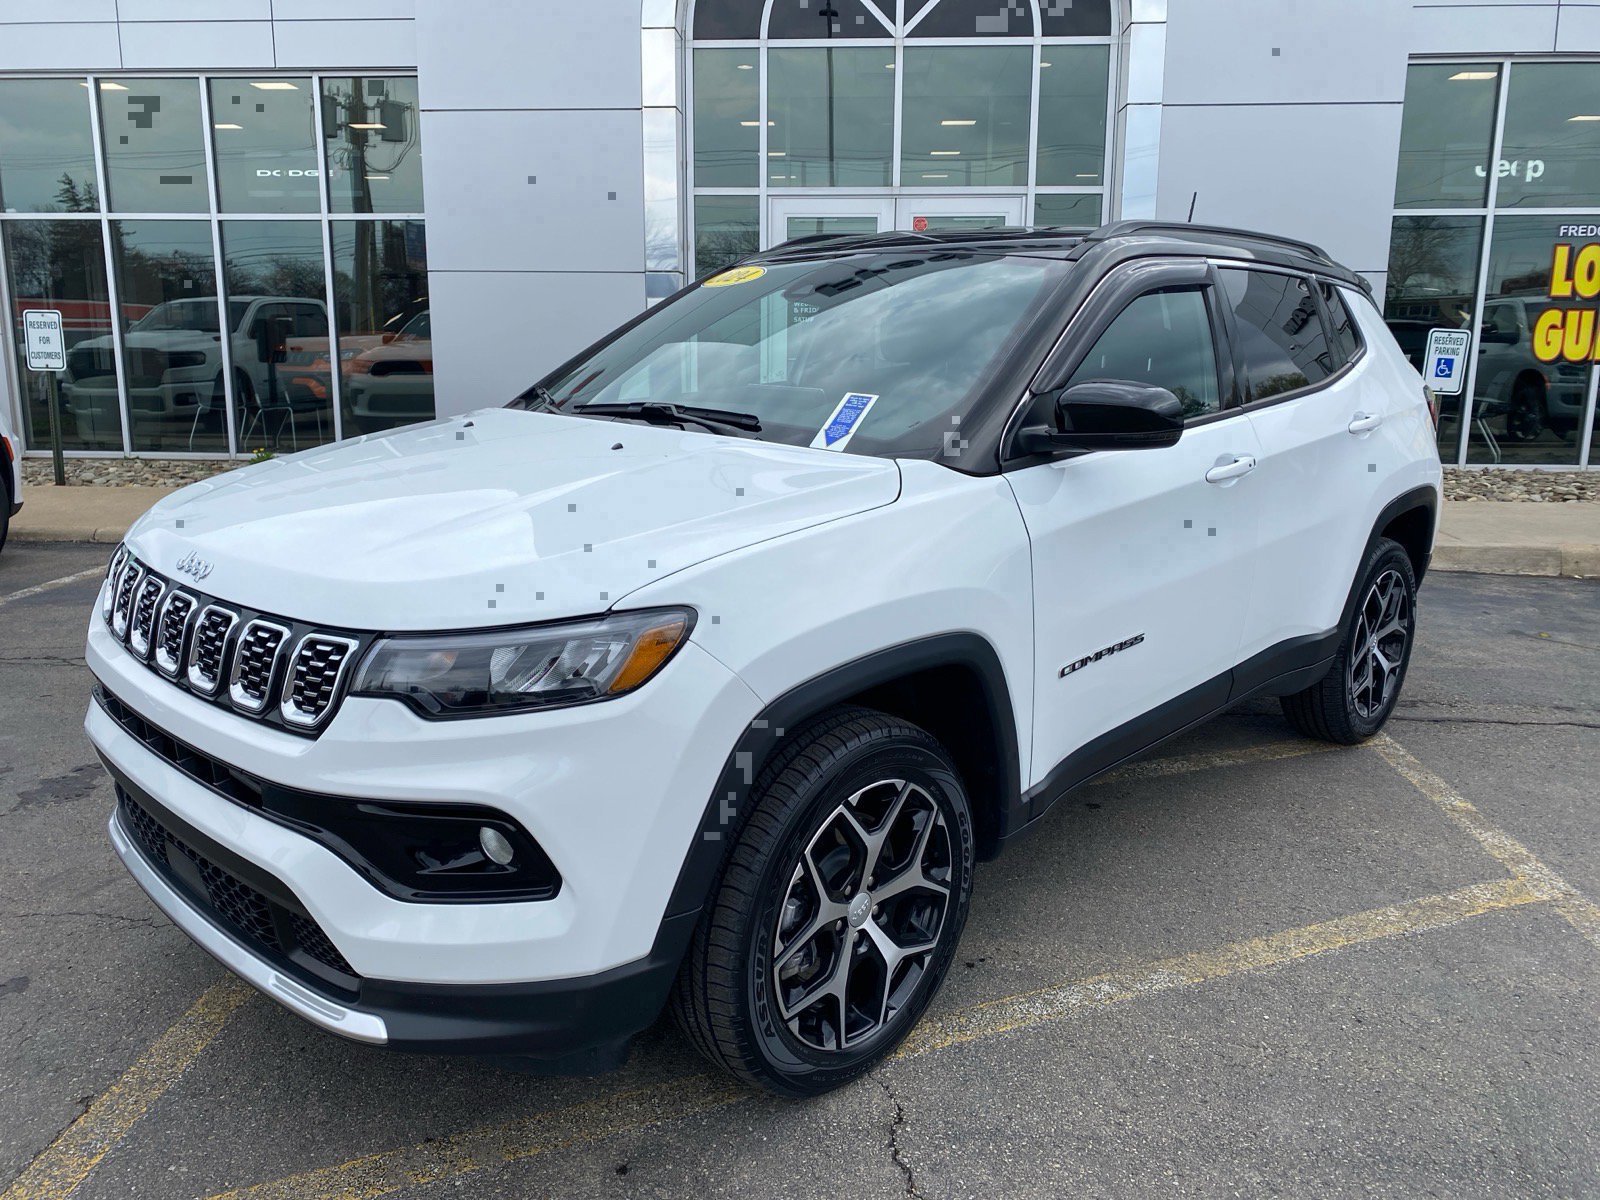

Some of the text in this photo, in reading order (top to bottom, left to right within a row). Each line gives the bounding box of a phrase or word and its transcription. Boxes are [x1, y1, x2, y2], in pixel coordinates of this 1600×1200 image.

[1559, 225, 1600, 237] FRED
[29, 321, 57, 330] RESERVED
[38, 336, 51, 344] FOR
[1532, 308, 1600, 363] GU
[1434, 336, 1464, 346] RESERVED
[31, 352, 61, 360] CUSTOMERS
[1435, 347, 1460, 356] PARKING
[176, 550, 215, 584] Jeep
[1058, 632, 1145, 679] COMPASS
